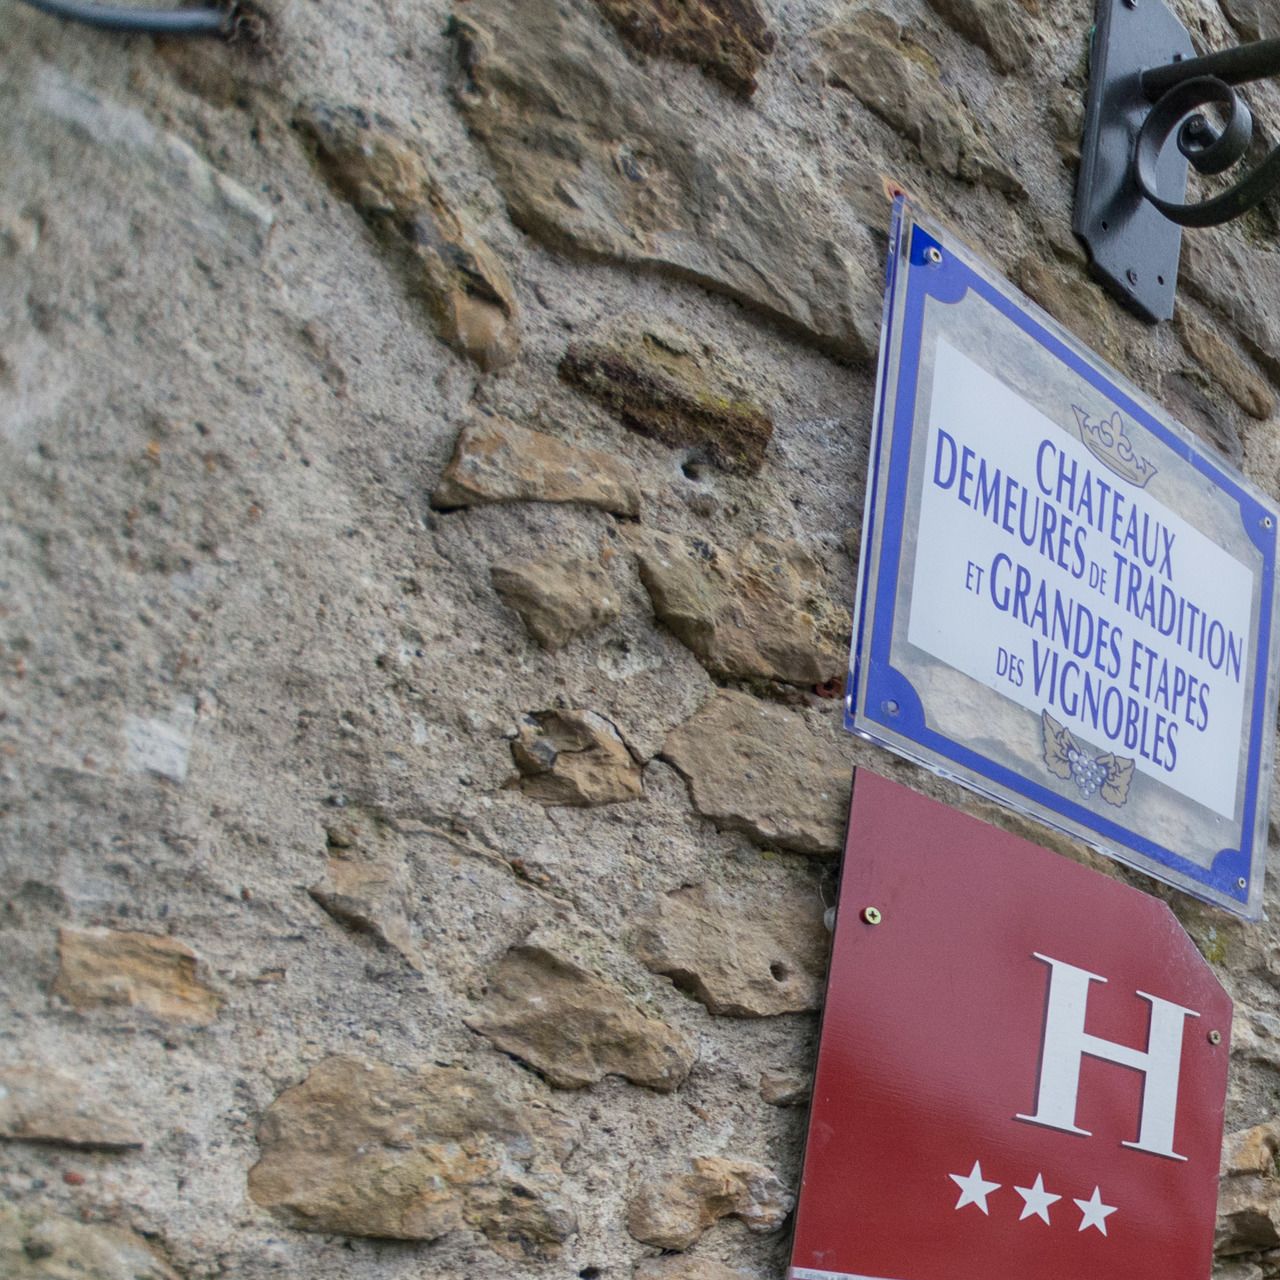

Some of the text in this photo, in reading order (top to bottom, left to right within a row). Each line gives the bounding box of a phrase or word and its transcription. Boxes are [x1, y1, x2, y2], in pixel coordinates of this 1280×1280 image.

[933, 428, 1243, 683] DEMEURES DE TRADITION
[1036, 439, 1175, 581] CHATEAUX
[965, 552, 1210, 732] ET GRANDES ETAPES
[996, 638, 1178, 772] DES VIGNOBLES
[1013, 951, 1201, 1161] H
